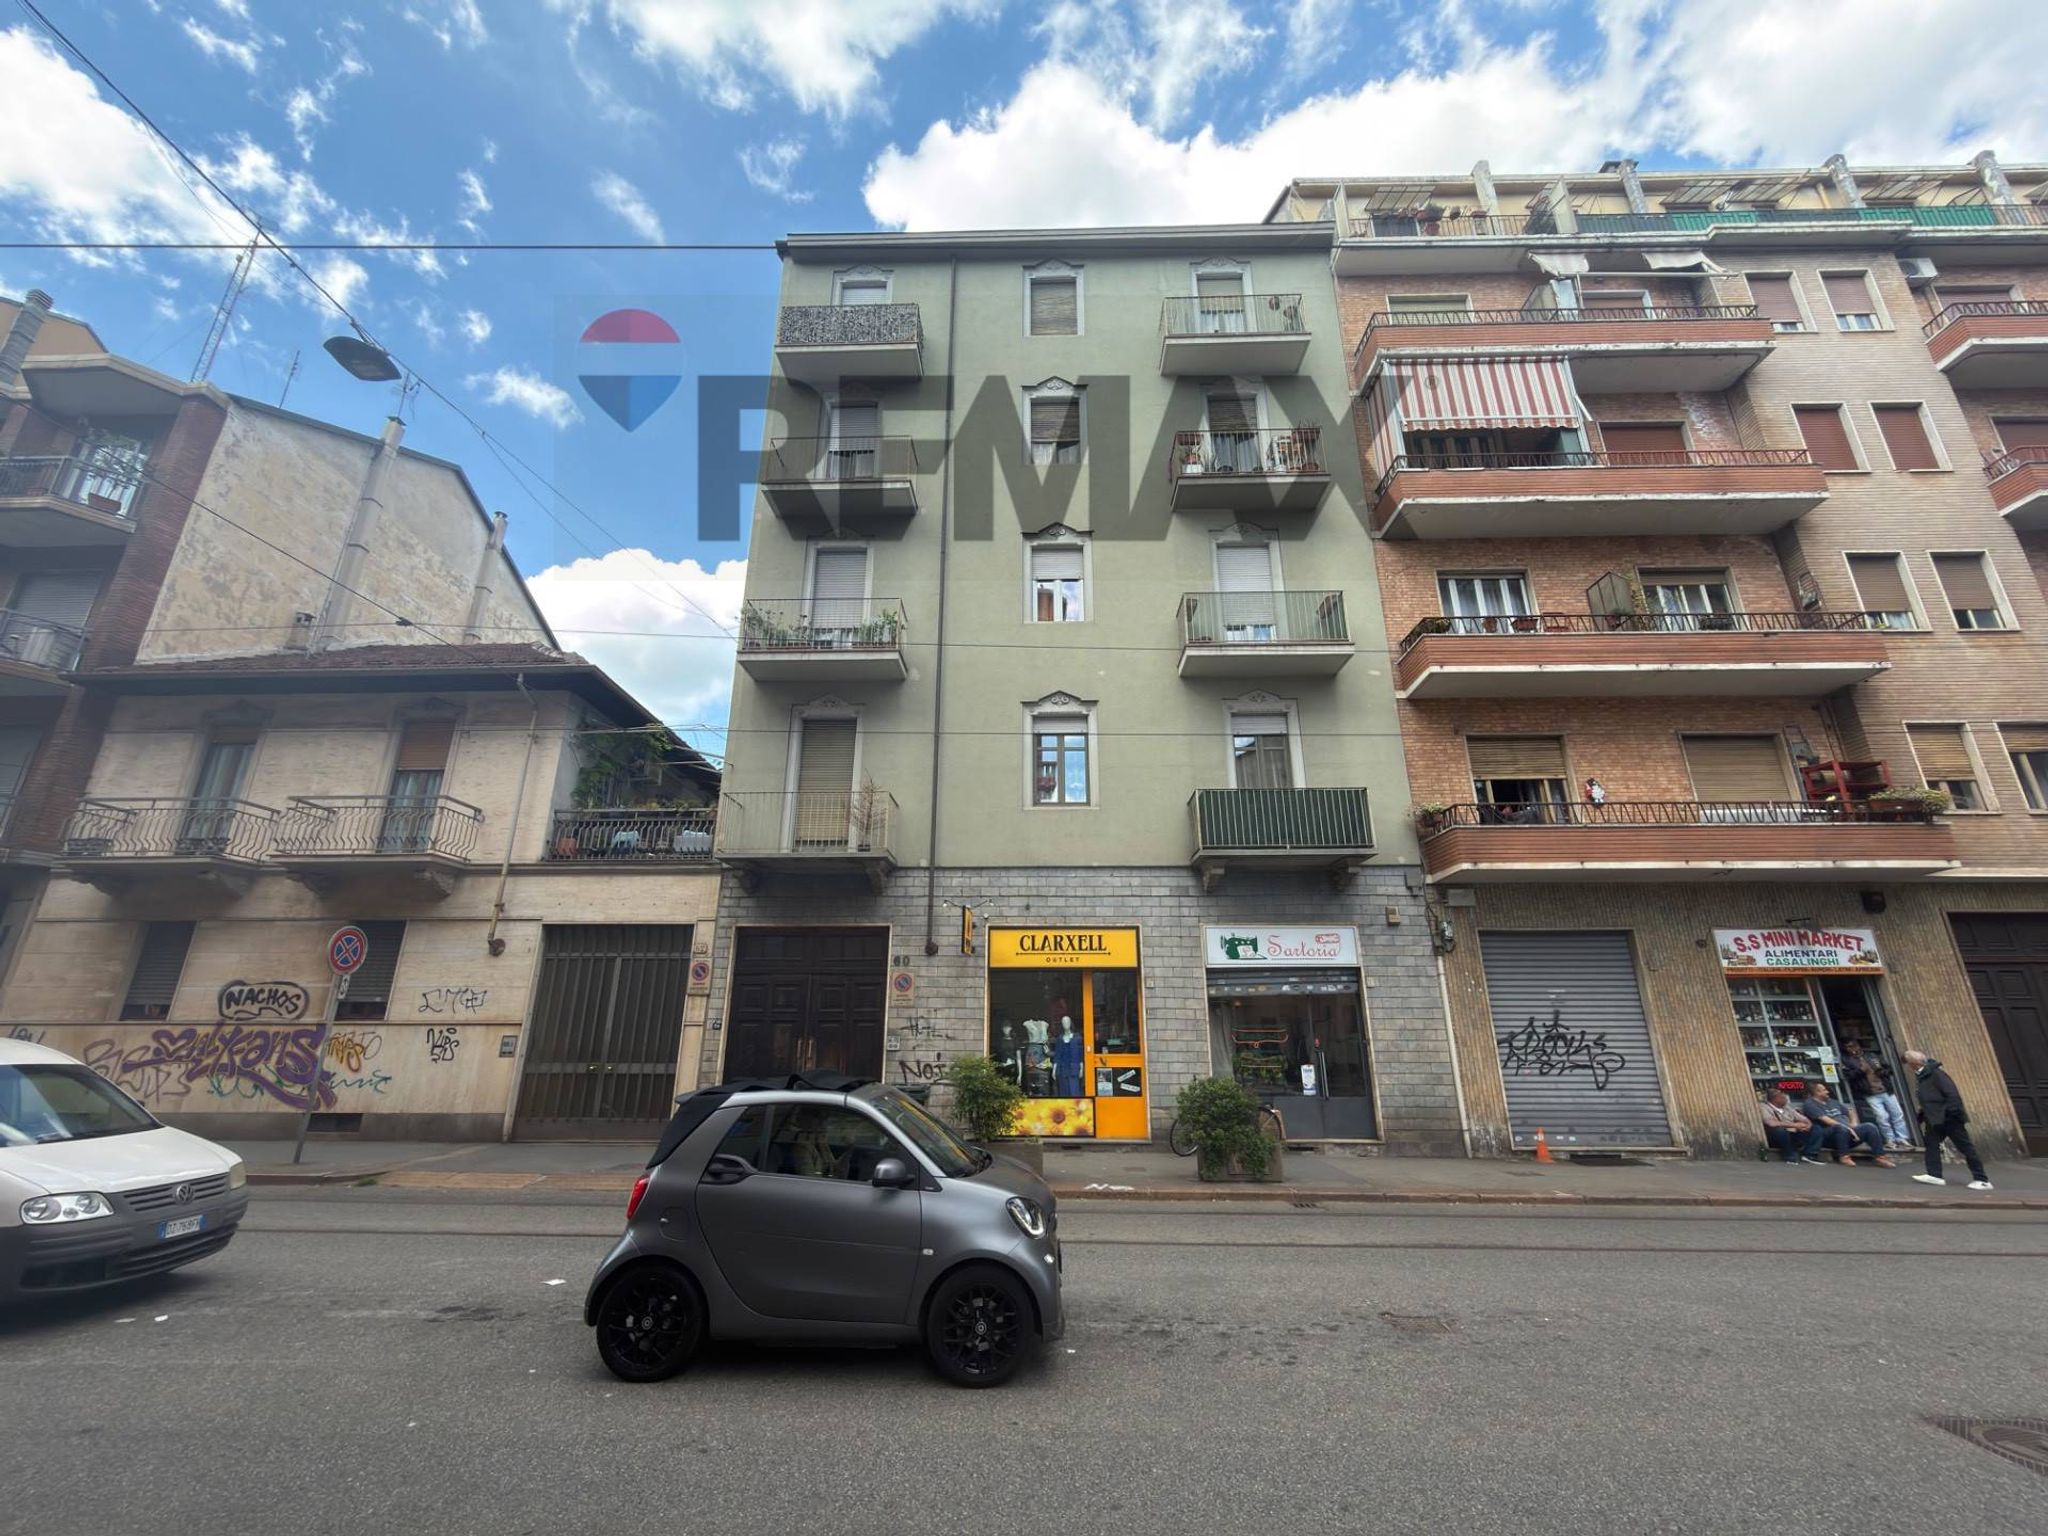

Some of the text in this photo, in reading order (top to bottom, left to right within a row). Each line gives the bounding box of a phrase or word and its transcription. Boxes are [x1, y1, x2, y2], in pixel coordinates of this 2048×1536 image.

[1020, 935, 1107, 951] CLARXELL
[1267, 934, 1338, 957] Sartoria
[1760, 931, 1796, 948] MINI
[1800, 931, 1864, 951] MARKET
[1765, 950, 1838, 958] ALIMENTARI
[1766, 958, 1839, 966] CASALINGHI
[226, 987, 301, 1014] NACHOS
